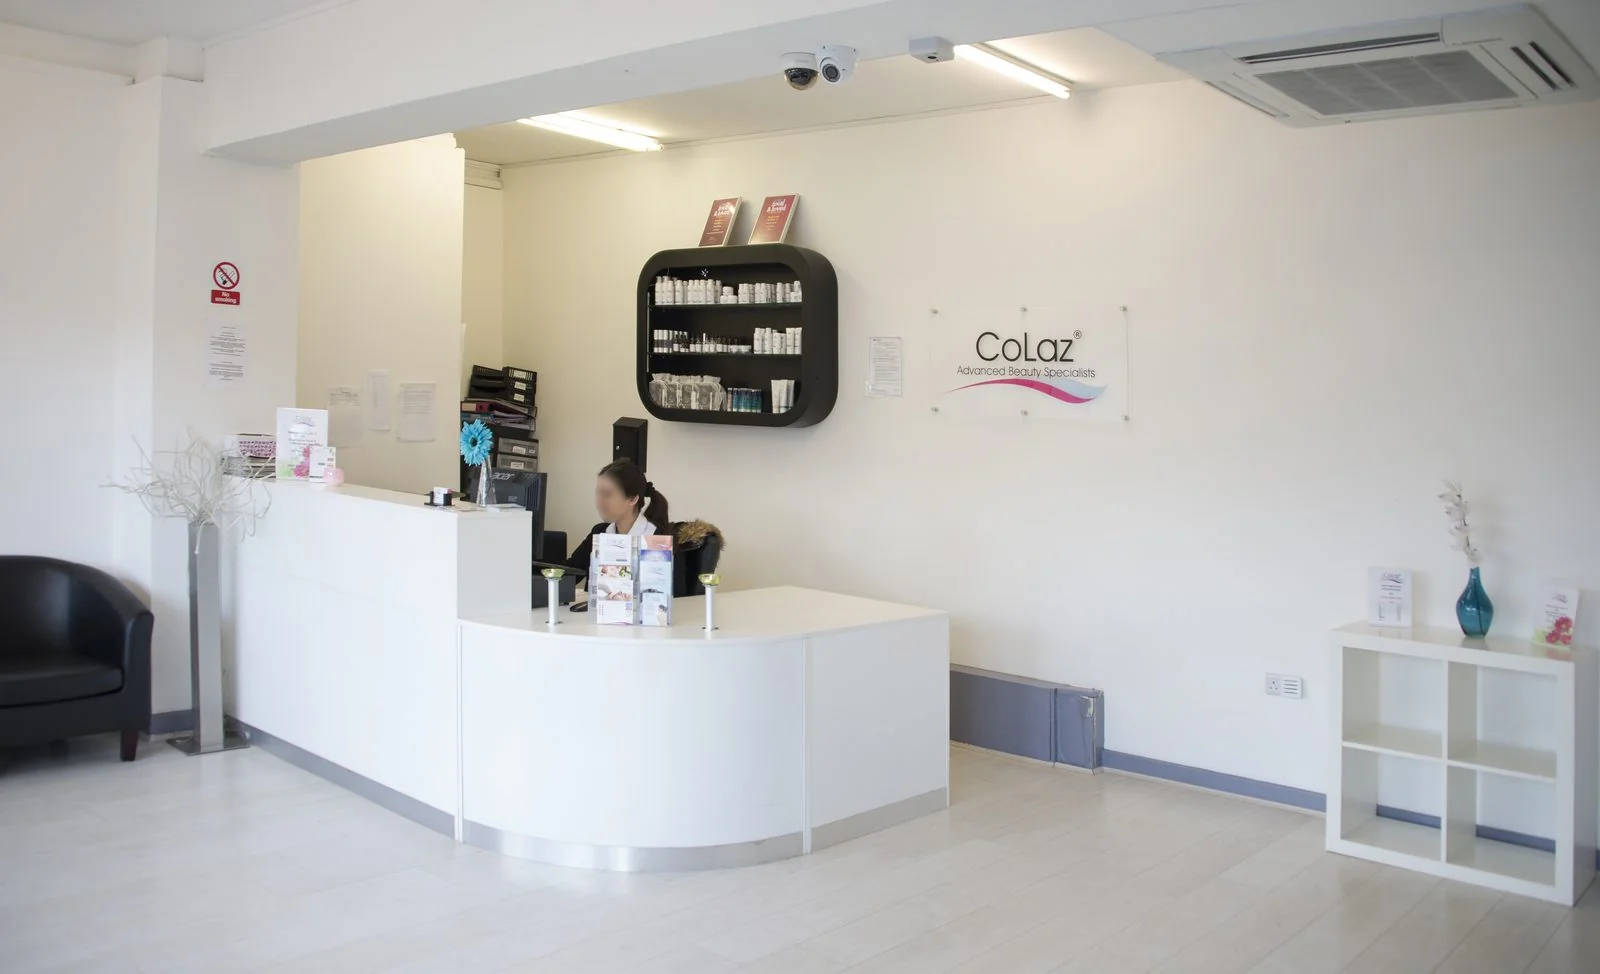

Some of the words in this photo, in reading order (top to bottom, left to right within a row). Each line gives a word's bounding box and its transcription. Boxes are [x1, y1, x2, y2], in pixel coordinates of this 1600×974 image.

[956, 365, 1006, 377] Advanced
[1008, 366, 1042, 378] Beauty
[1044, 366, 1096, 378] Specialists
[492, 472, 515, 480] acer
